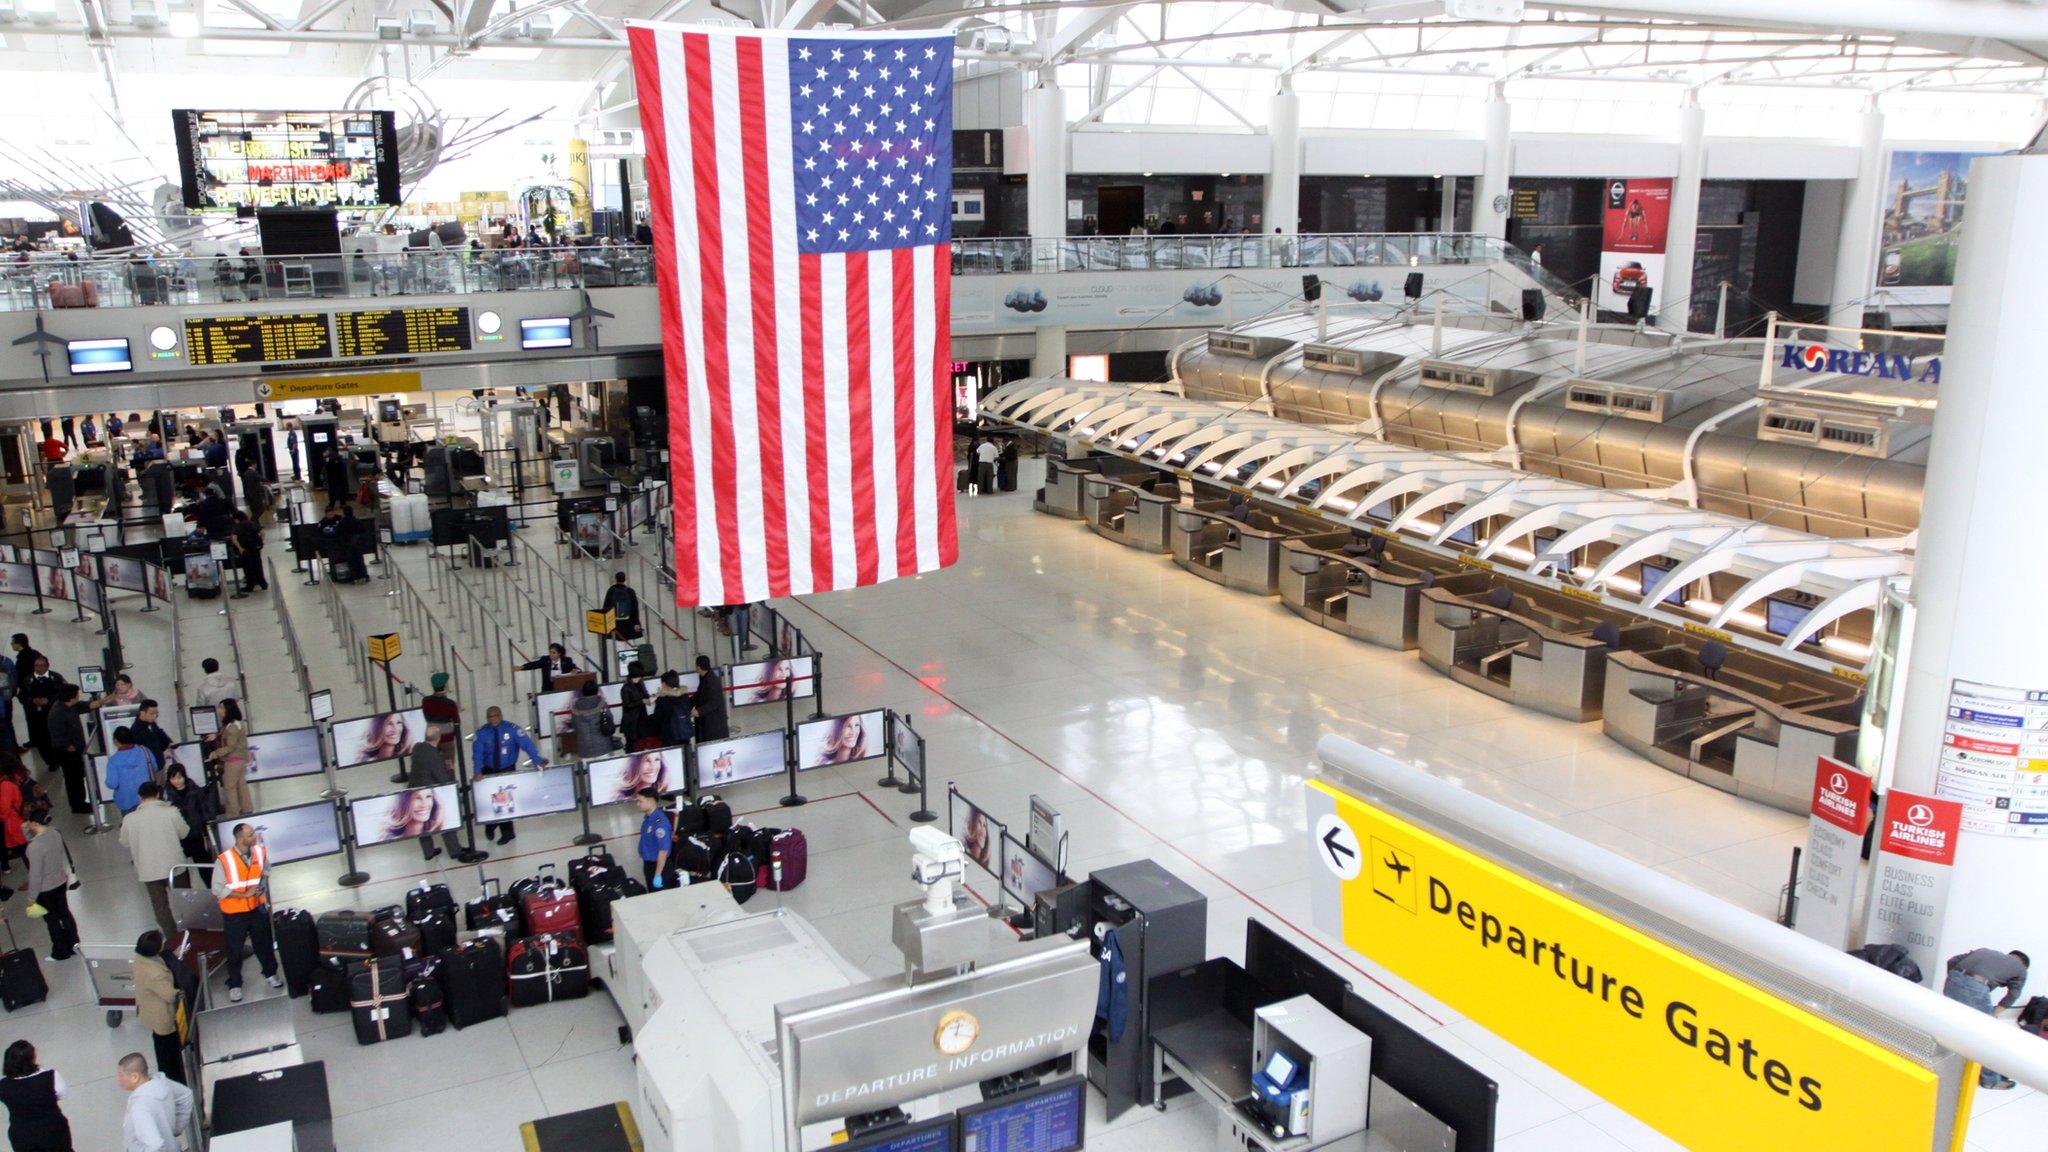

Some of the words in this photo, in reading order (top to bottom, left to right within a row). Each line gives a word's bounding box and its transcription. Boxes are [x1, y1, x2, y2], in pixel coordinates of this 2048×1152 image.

[373, 114, 383, 146] TERMINAL
[377, 147, 386, 163] ONE
[247, 164, 309, 180] MARTINI
[315, 163, 347, 180] BAR
[350, 162, 369, 180] AT
[215, 185, 290, 203] BETWEEN
[295, 183, 338, 202] GATE
[1781, 344, 1918, 381] KOREAN
[290, 383, 333, 392] Departure
[335, 381, 359, 389] Gates
[1818, 796, 1857, 819] AIRLINES
[1820, 787, 1857, 809] TURKISH
[1814, 825, 1847, 849] ECONOMY
[1890, 830, 1945, 849] AIRLINES
[1892, 820, 1946, 840] TURKISH
[1812, 839, 1834, 859] CLASS
[1810, 853, 1843, 878] COMFORT
[1808, 867, 1831, 888] CLASS
[1884, 865, 1935, 888] BUSINESS
[1806, 881, 1838, 906] CHECK-IN
[1882, 879, 1914, 898] CLASS
[1879, 894, 1905, 910] ELITE
[1907, 901, 1935, 918] PLUS
[1877, 908, 1904, 926] ELITE
[1907, 931, 1935, 949] GOLD
[1428, 876, 1646, 1020] Departure
[1665, 1001, 1824, 1113] Gates
[816, 1063, 939, 1108] DEPARTURE
[949, 1023, 1080, 1073] INFORMATION
[1024, 1090, 1073, 1111] DEPARTURES
[889, 1129, 943, 1151] DEPARTURES
